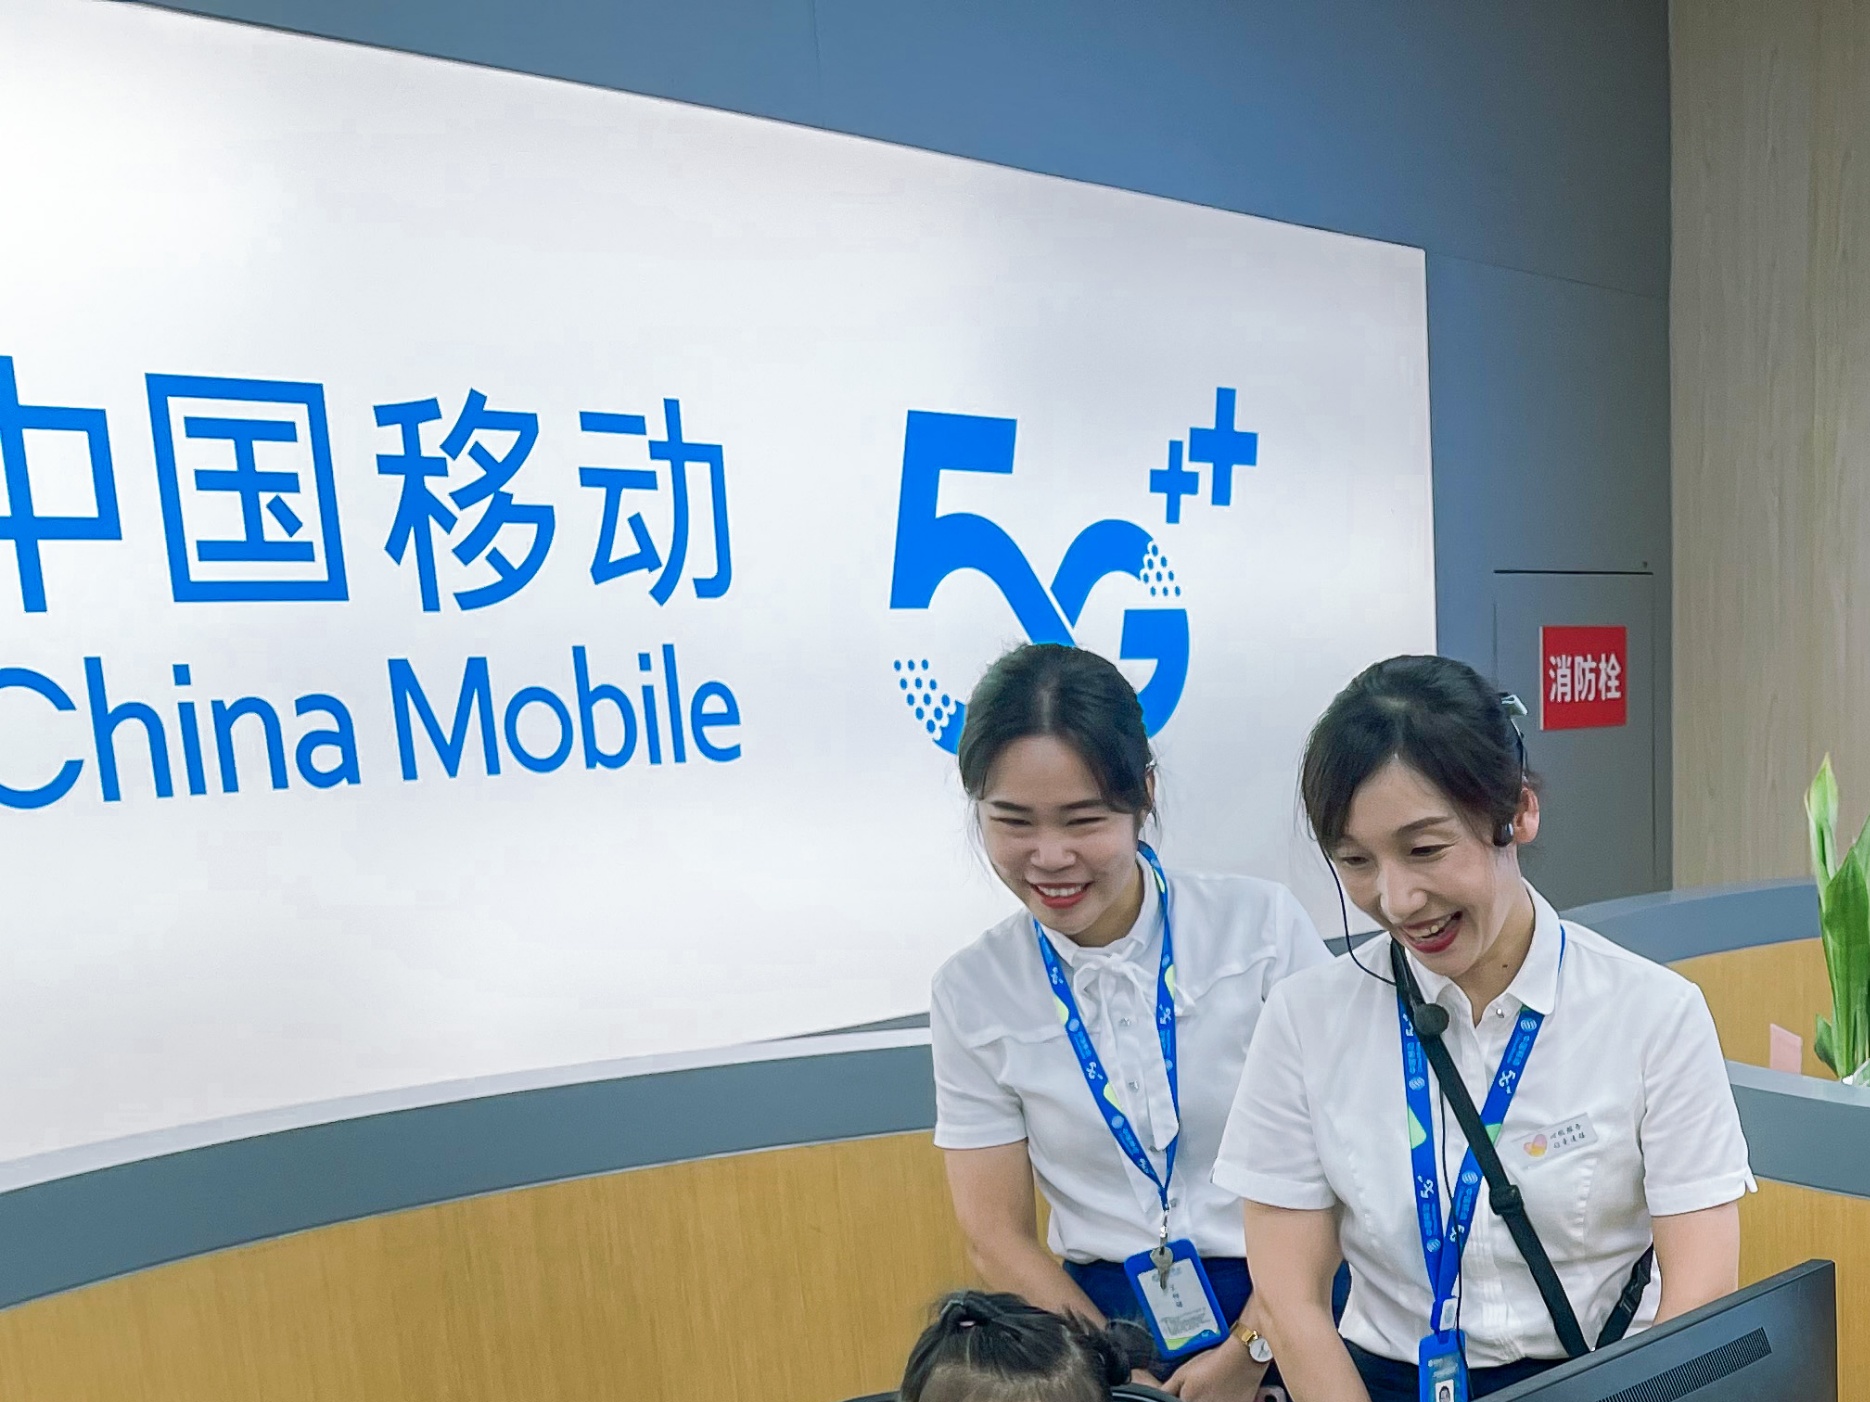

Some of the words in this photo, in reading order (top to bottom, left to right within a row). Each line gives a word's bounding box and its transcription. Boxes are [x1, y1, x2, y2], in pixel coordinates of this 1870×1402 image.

[0, 356, 732, 613] 中国移动
[0, 656, 361, 810] China
[387, 643, 742, 782] Mobile
[1549, 653, 1621, 703] 消防栓
